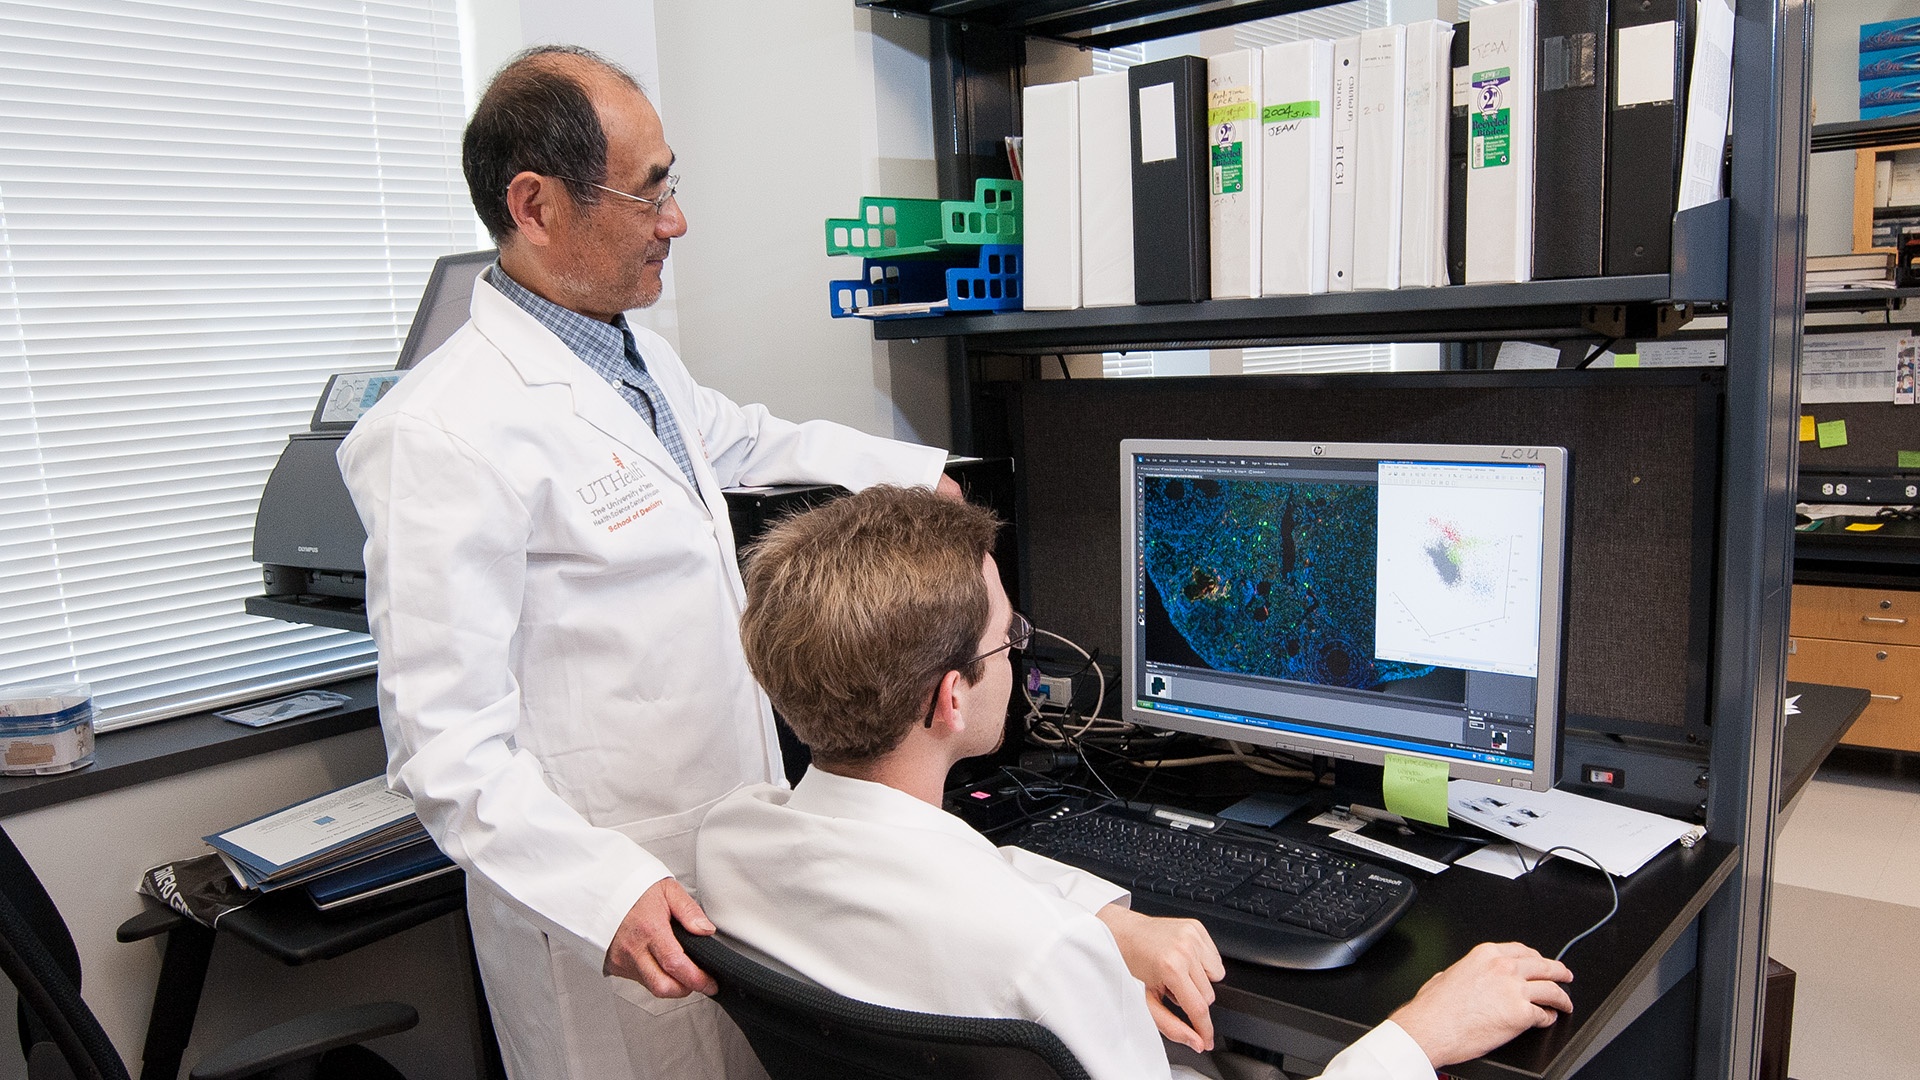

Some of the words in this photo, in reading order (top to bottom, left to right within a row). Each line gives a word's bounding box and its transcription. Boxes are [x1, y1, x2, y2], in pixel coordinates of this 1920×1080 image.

[1264, 105, 1293, 118] 2004
[1268, 120, 1302, 137] JEAN
[1472, 115, 1508, 130] Recycled
[1477, 127, 1506, 137] Binder
[1212, 147, 1241, 161] Recycled
[591, 506, 606, 517] The
[606, 490, 640, 510] University
[608, 516, 632, 533] School
[632, 510, 640, 520] of
[640, 499, 664, 517] Dentistry
